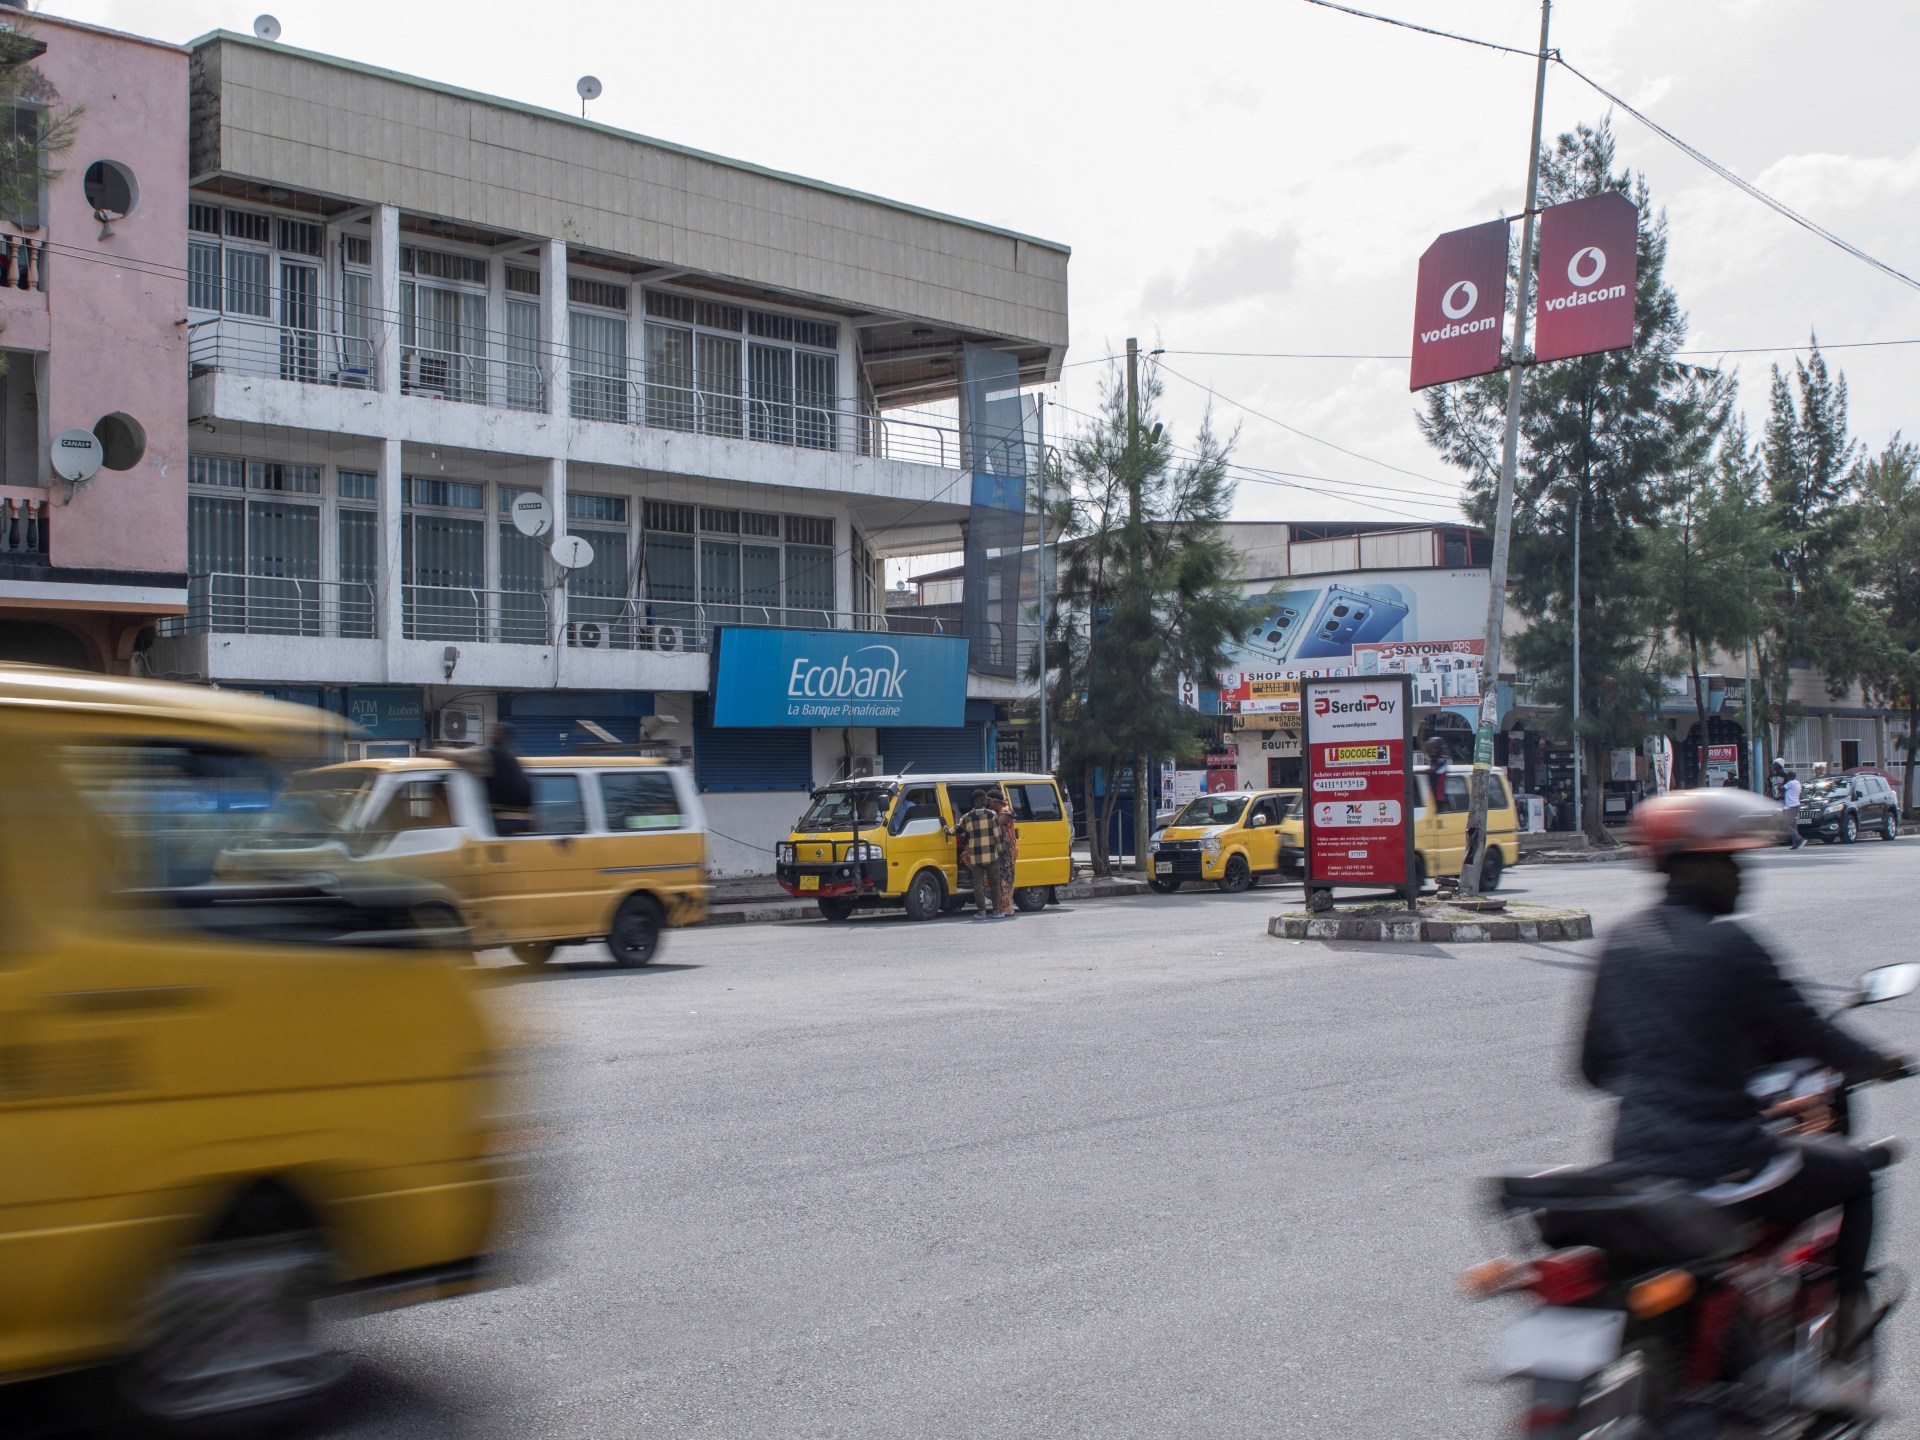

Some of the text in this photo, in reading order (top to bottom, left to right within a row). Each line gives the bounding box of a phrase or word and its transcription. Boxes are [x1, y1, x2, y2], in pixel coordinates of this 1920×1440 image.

[1545, 284, 1626, 311] vodacom
[1421, 316, 1496, 344] vodacom
[1396, 644, 1452, 655] SAYONA
[788, 645, 908, 698] Ecobank
[1248, 670, 1320, 680] SHOP C.E.D
[352, 700, 420, 715] ATM Ecobank
[788, 704, 900, 718] La Banque Panafricaine
[1332, 694, 1396, 714] SerdiPay
[1262, 741, 1298, 750] EQUITY
[1340, 748, 1376, 759] SOCODEE
